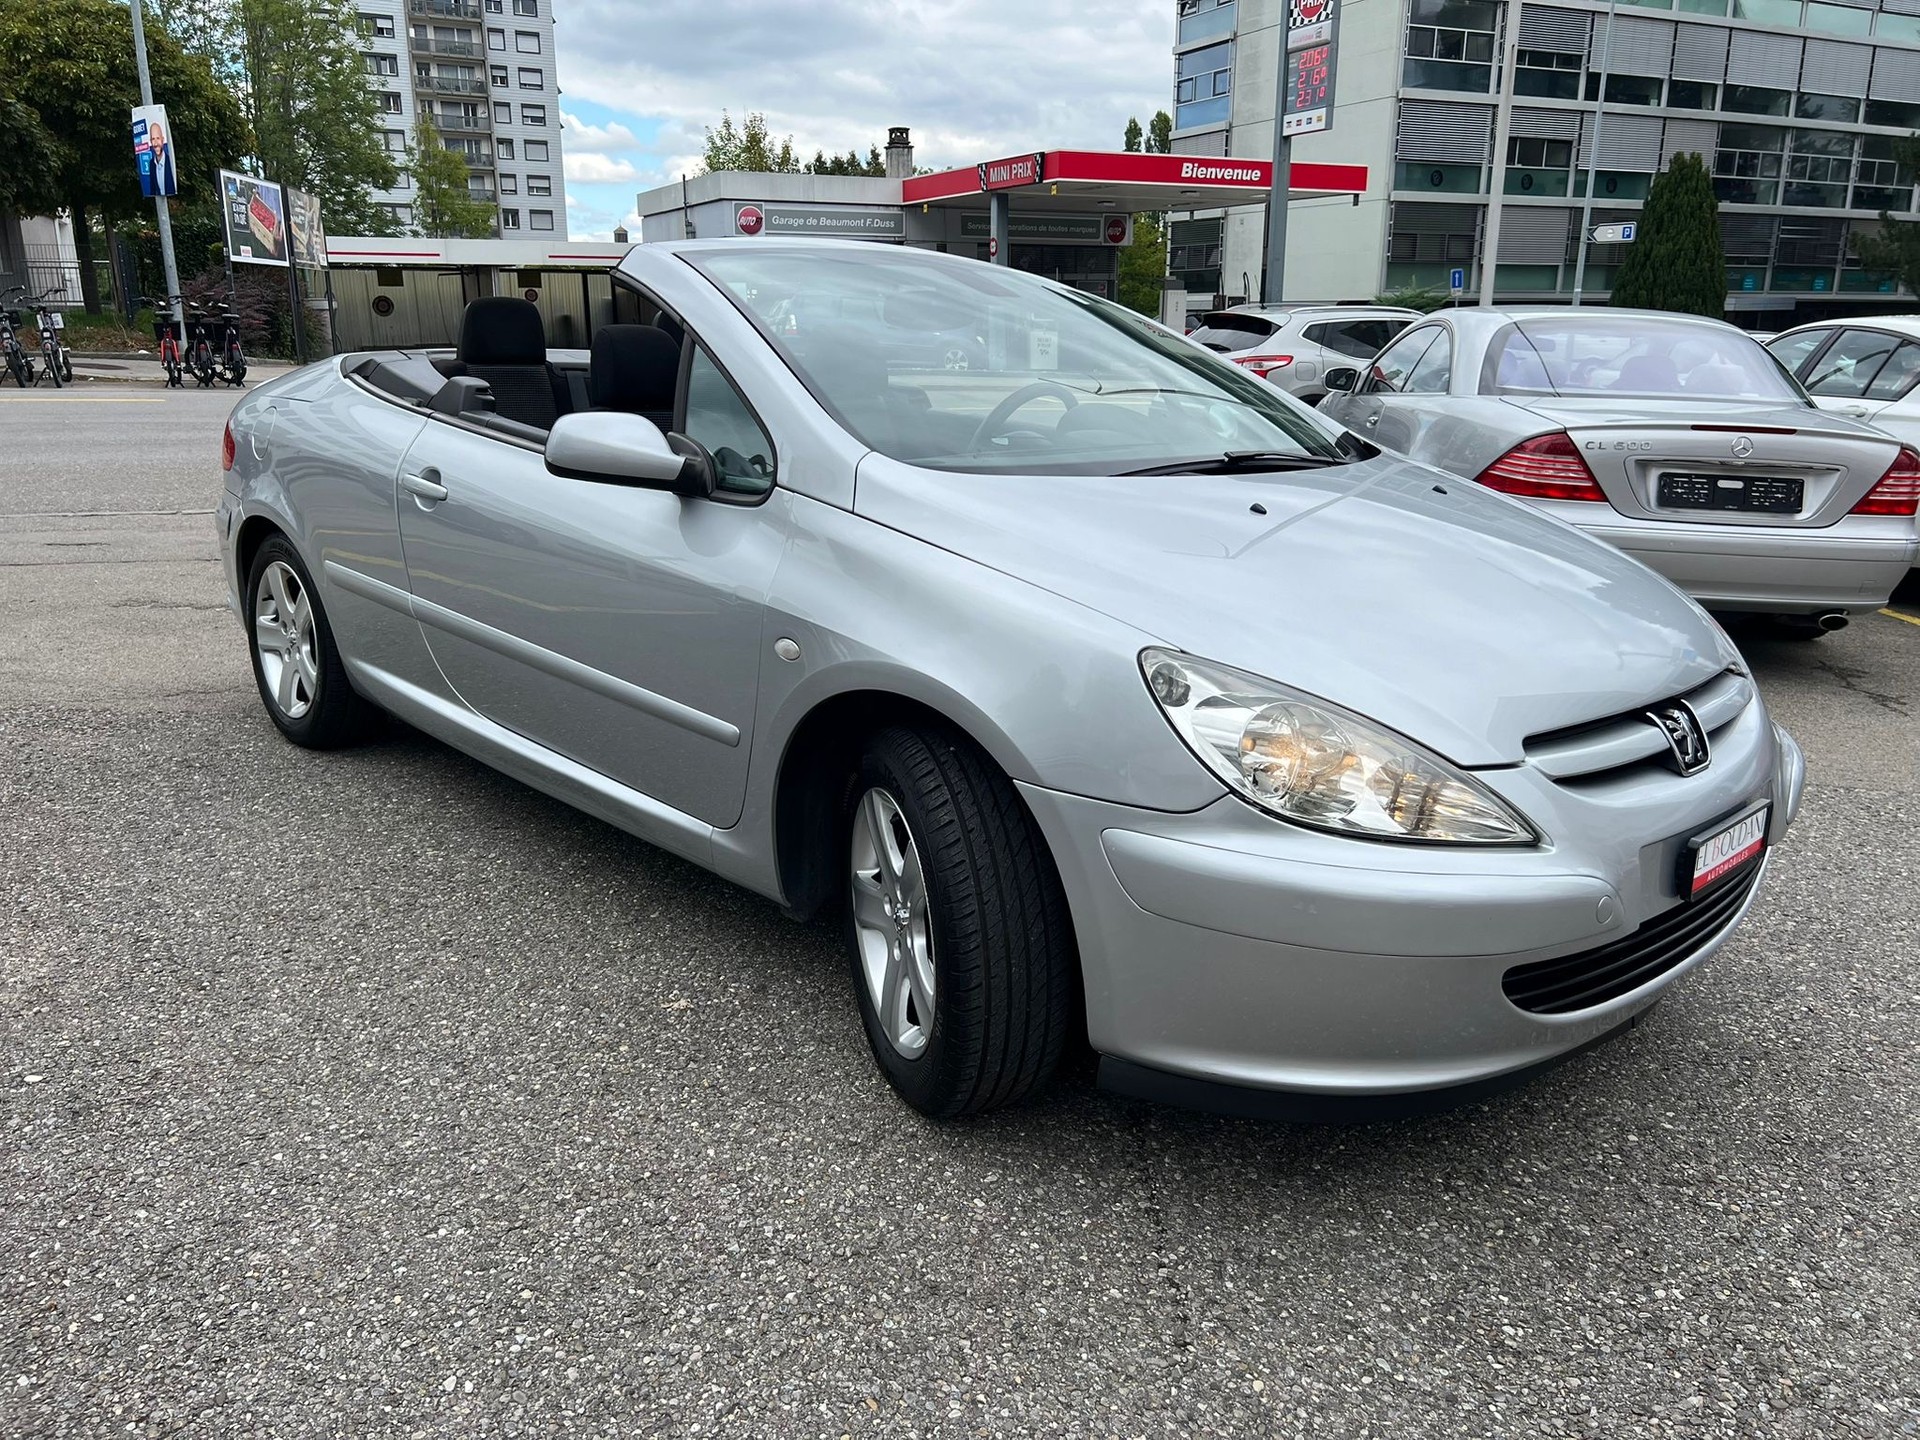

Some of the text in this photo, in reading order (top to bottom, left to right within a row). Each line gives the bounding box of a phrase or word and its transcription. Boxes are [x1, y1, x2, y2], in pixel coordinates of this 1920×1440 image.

[989, 160, 1033, 183] MINI PRIX
[1181, 162, 1261, 181] Bienvenue
[771, 215, 895, 228] Garage de Beaumont F.Duss
[1069, 226, 1097, 235] marques
[1585, 441, 1607, 451] CL
[1706, 849, 1749, 882] AUTOMOBILES
